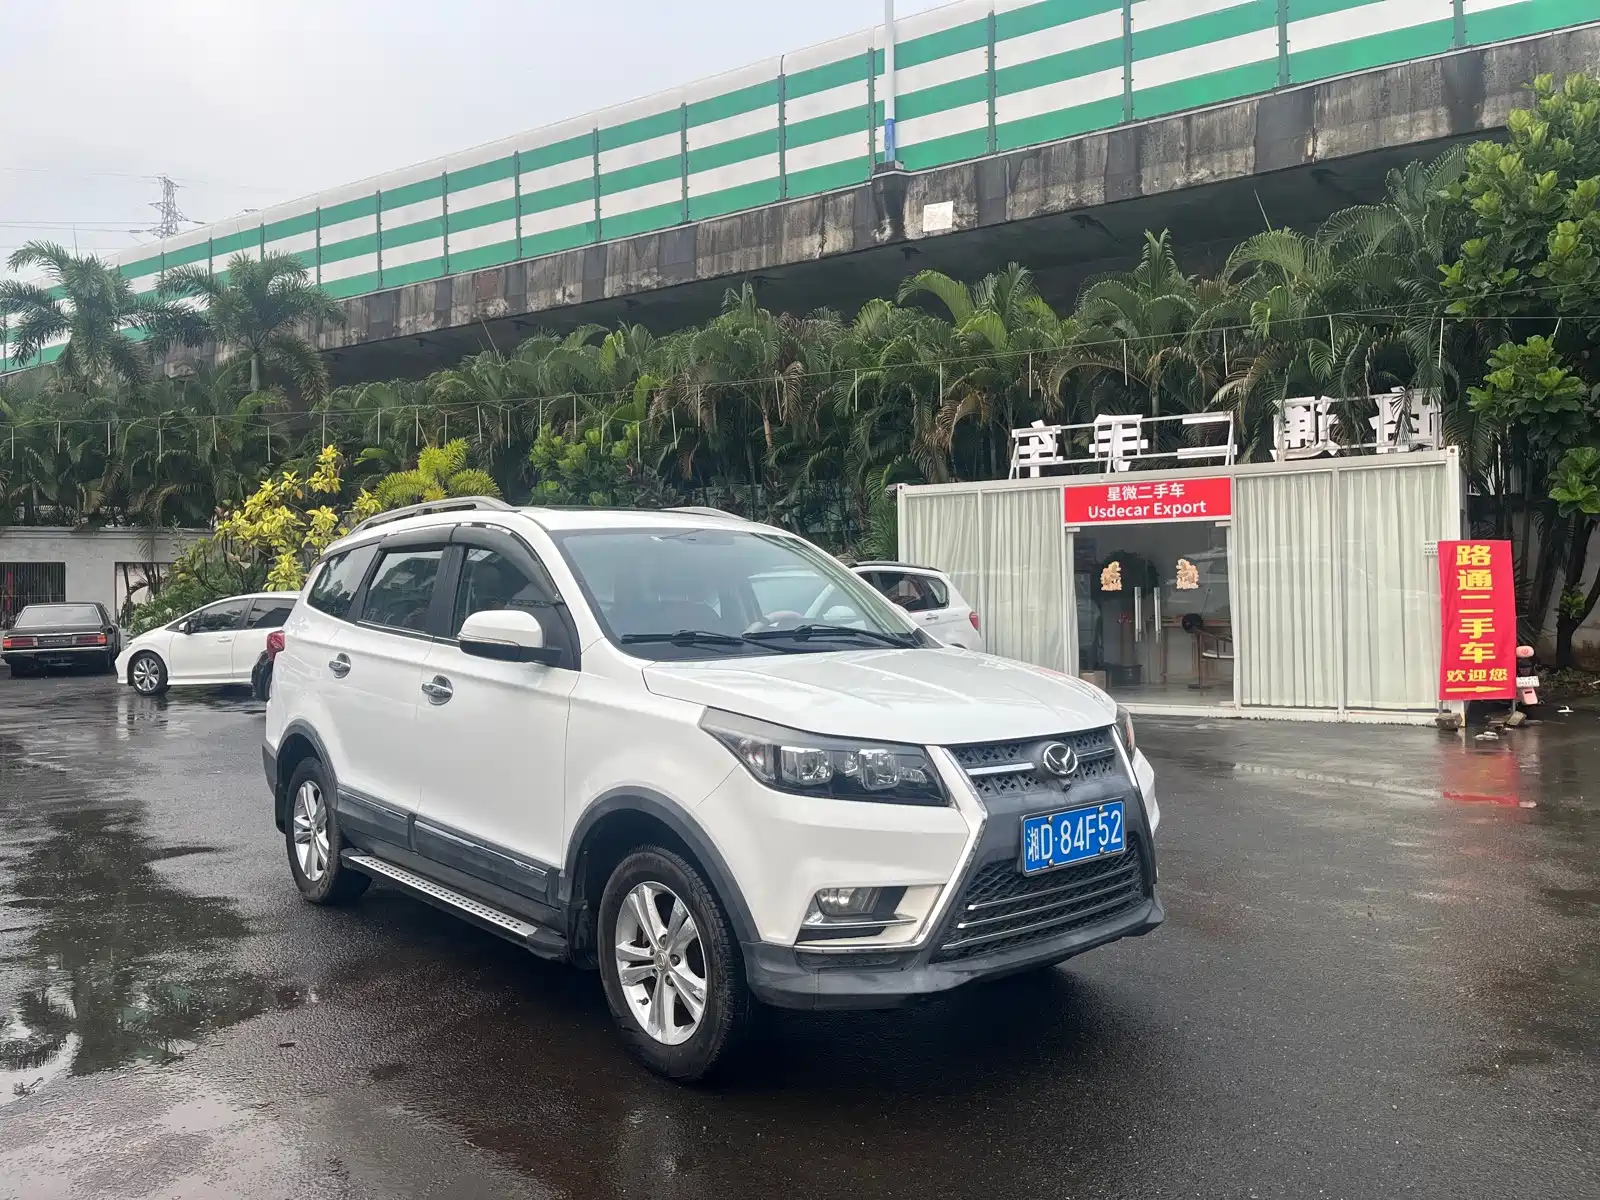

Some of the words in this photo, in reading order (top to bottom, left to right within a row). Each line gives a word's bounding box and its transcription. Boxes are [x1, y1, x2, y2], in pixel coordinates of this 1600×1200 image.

[1107, 483, 1185, 502] 星微二手车
[1088, 505, 1150, 519] Usdecar
[1153, 500, 1207, 517] Export
[1456, 545, 1496, 663] 路通二手车
[1446, 668, 1508, 682] 欢迎您
